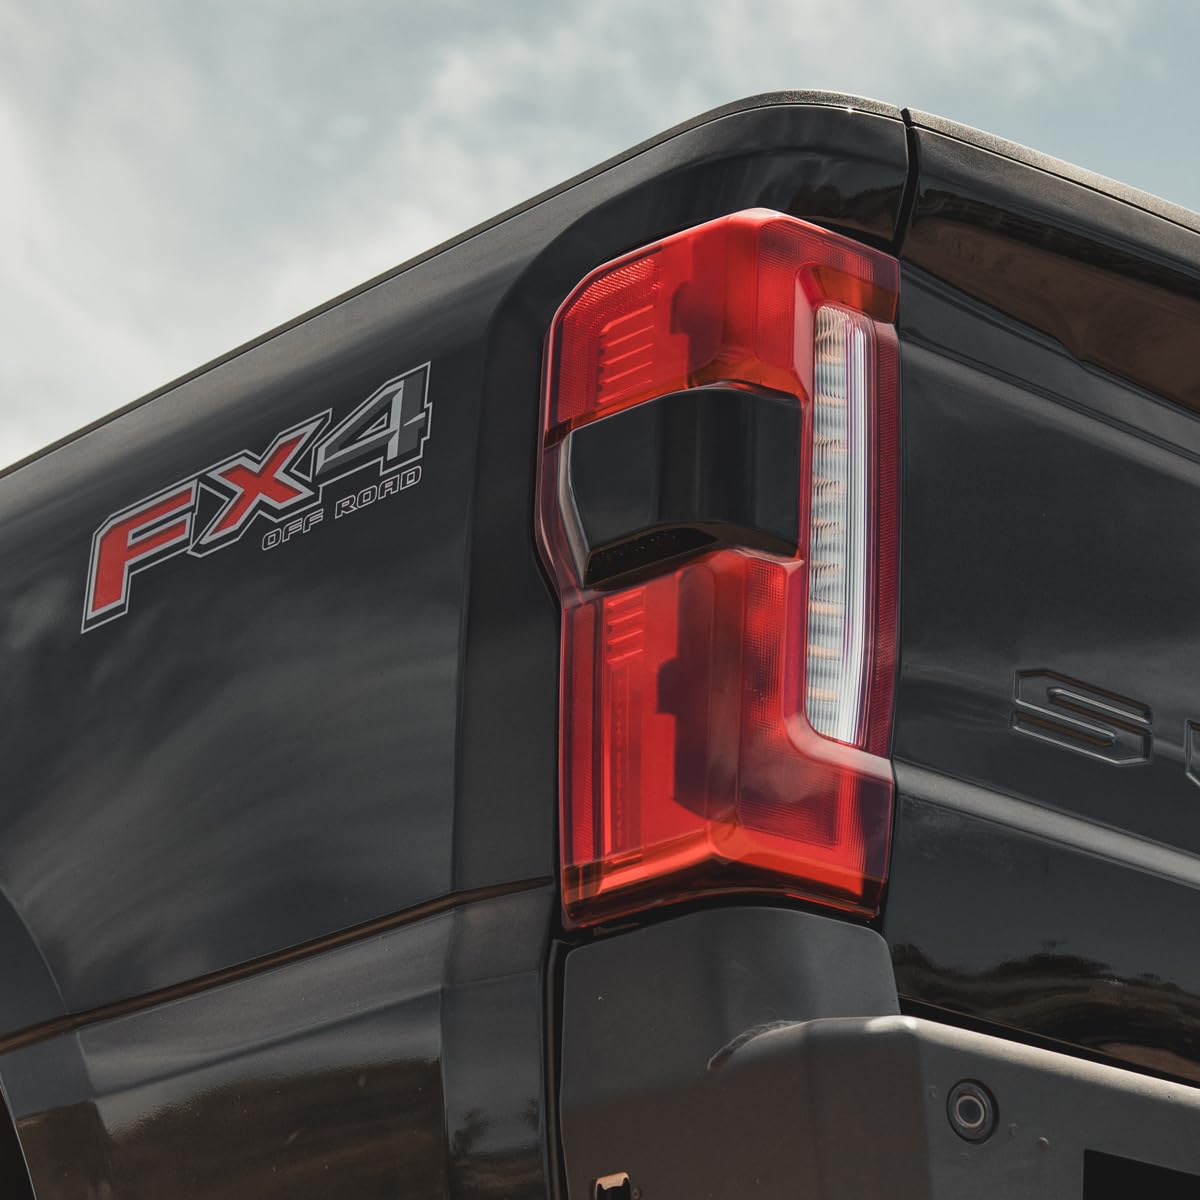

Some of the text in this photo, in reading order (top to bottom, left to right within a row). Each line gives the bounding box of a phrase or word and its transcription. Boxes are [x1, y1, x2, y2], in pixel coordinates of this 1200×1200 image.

[81, 361, 432, 634] FX4
[262, 465, 422, 550] OFF ROAD
